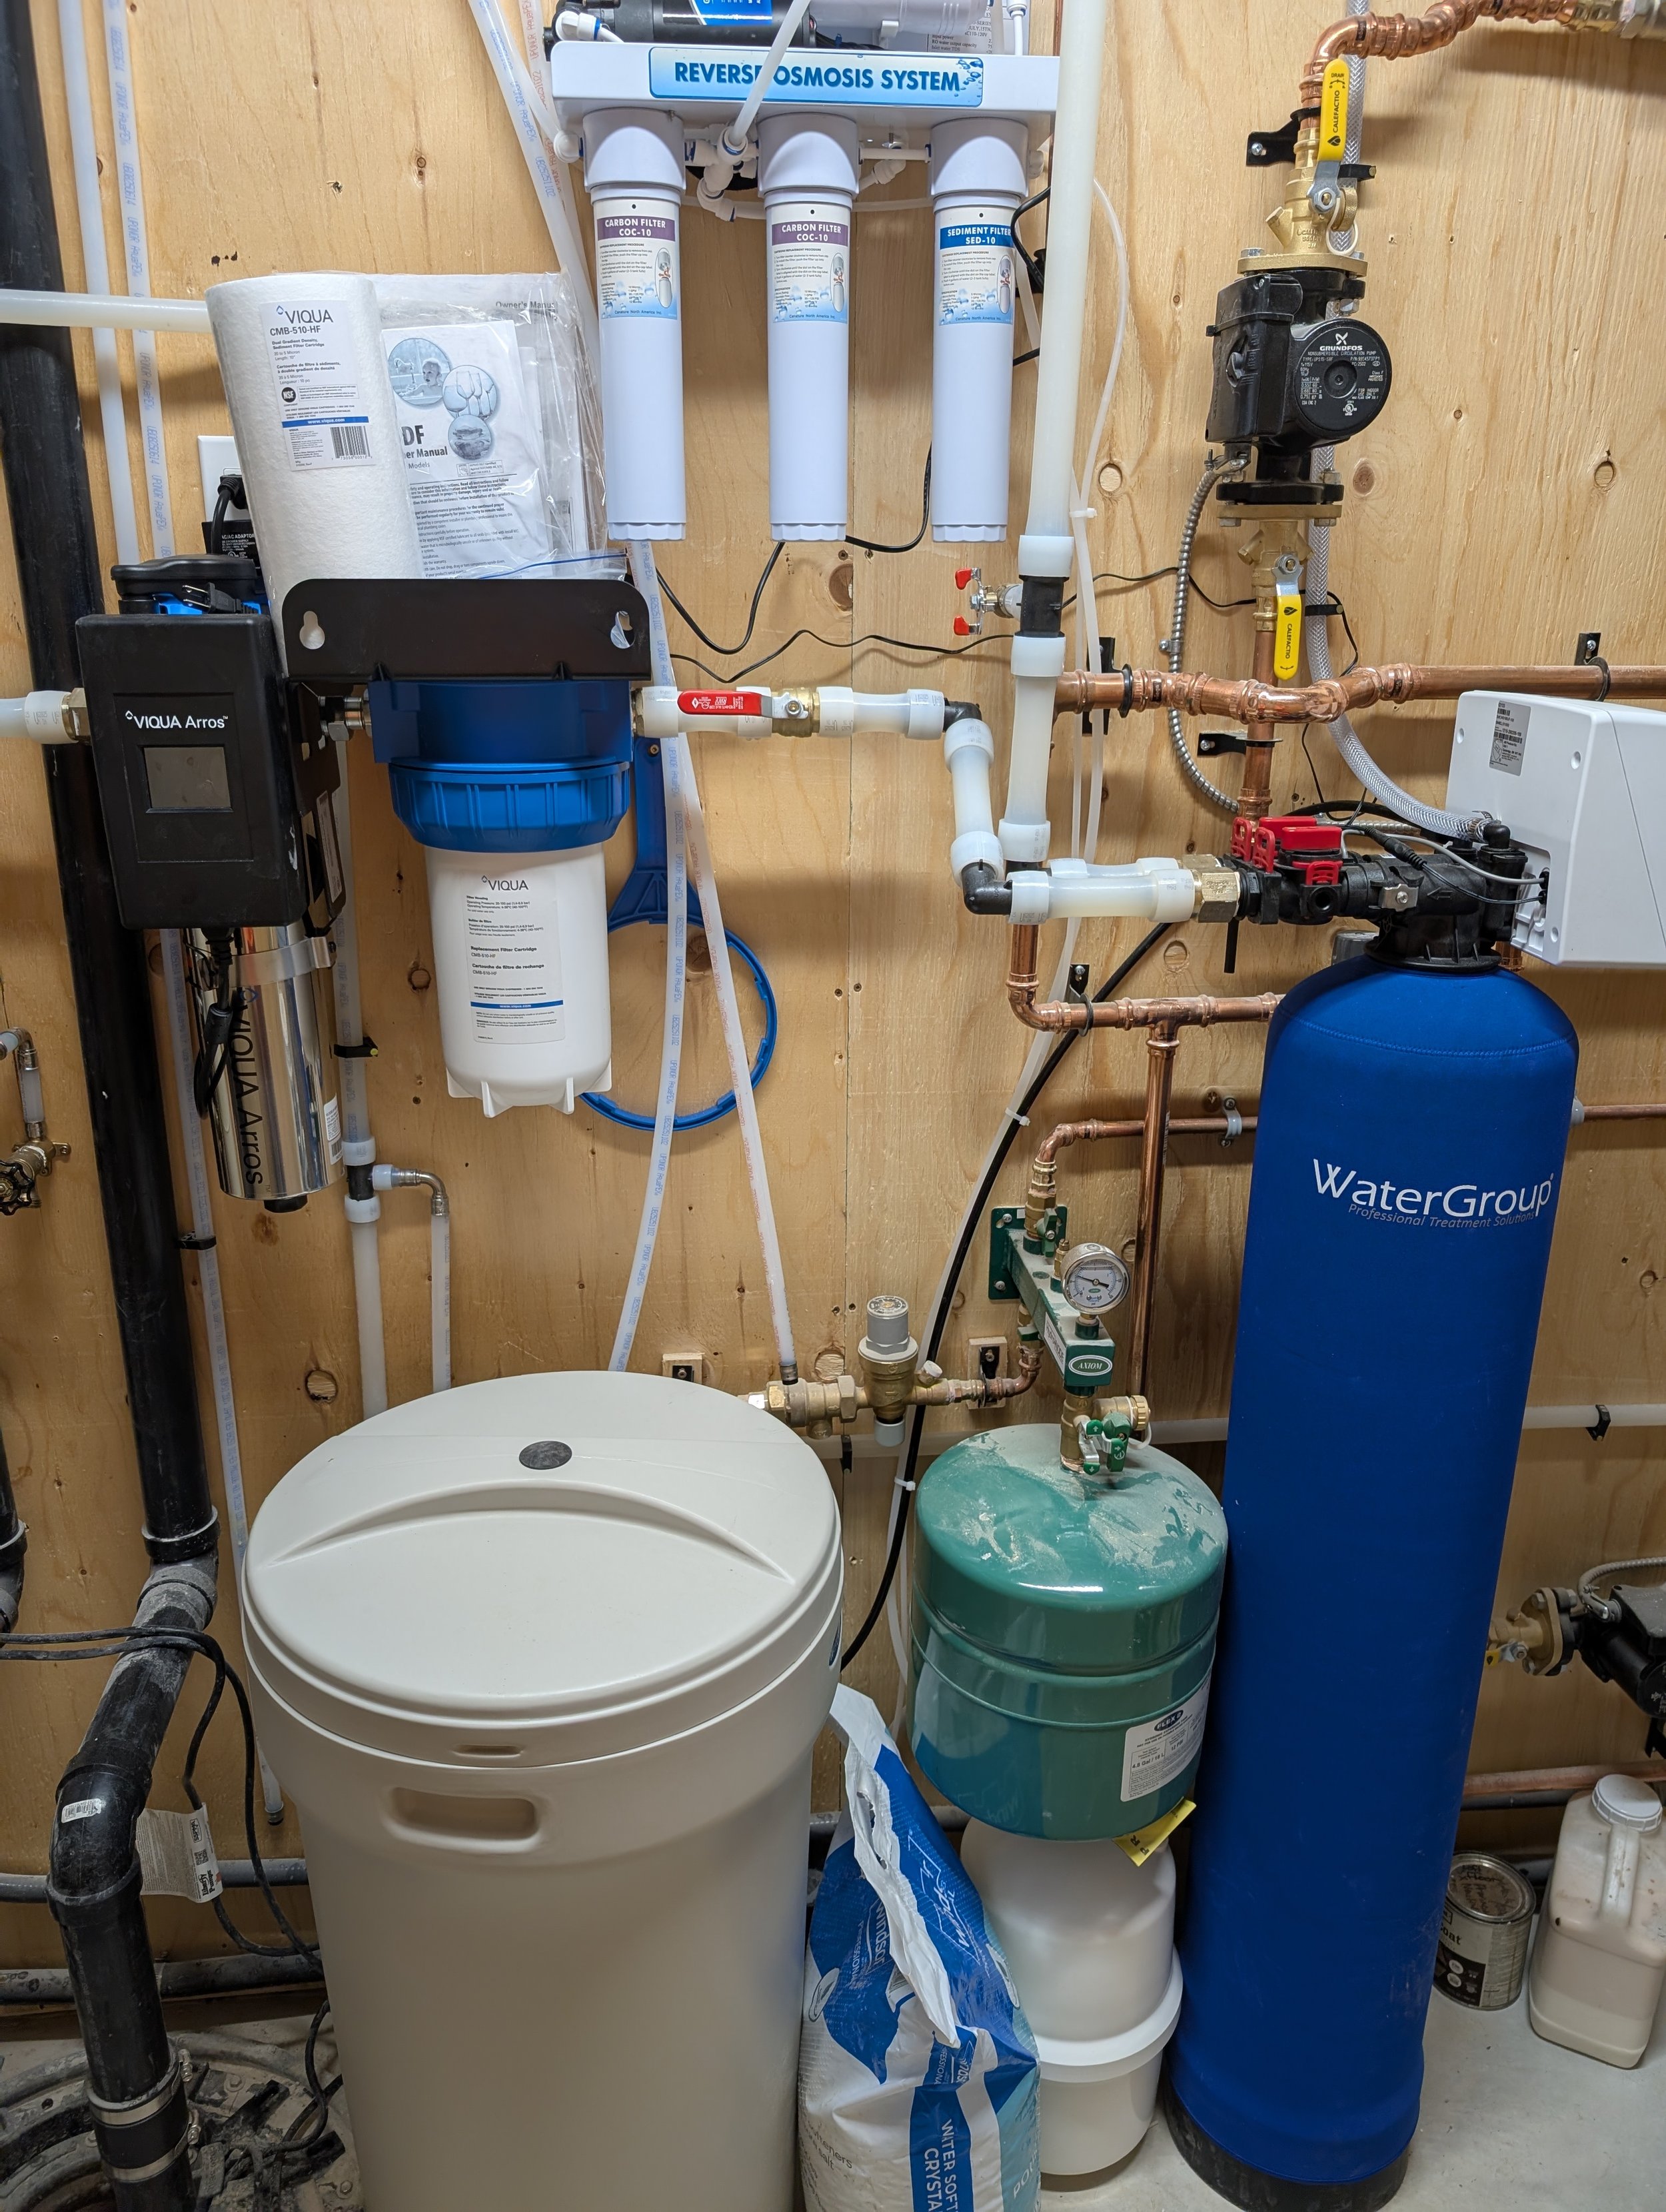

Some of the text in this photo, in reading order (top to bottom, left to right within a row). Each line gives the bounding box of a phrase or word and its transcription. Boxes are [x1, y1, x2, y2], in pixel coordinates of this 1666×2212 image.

[773, 65, 874, 89] OSMOSIS
[880, 69, 960, 92] SYSTEM
[1332, 90, 1341, 133] CALEFACTIO
[605, 218, 666, 229] CARBON FILTER
[782, 223, 841, 233] CARBON FILTER
[796, 233, 828, 242] COC-10
[947, 227, 1011, 237] SEDIMENT FILTER
[285, 309, 334, 324] VIQUA
[270, 325, 321, 336] CMB-510-HF
[283, 390, 295, 400] NSF
[416, 446, 448, 458] Manual
[133, 715, 182, 729] VIQUA
[488, 879, 529, 891] VIQUA
[228, 1004, 259, 1103] VIQUA
[1313, 1158, 1554, 1217] WaterGroup
[1348, 1203, 1535, 1229] Professional Treatment Solutions
[1156, 1716, 1177, 1730] FLEX
[189, 1820, 201, 1842] SSPMA
[198, 1873, 209, 1897] Liberty
[207, 1870, 216, 1894] Pumps
[1441, 1923, 1462, 1945] oat
[924, 2147, 944, 2212] CRYSTA
